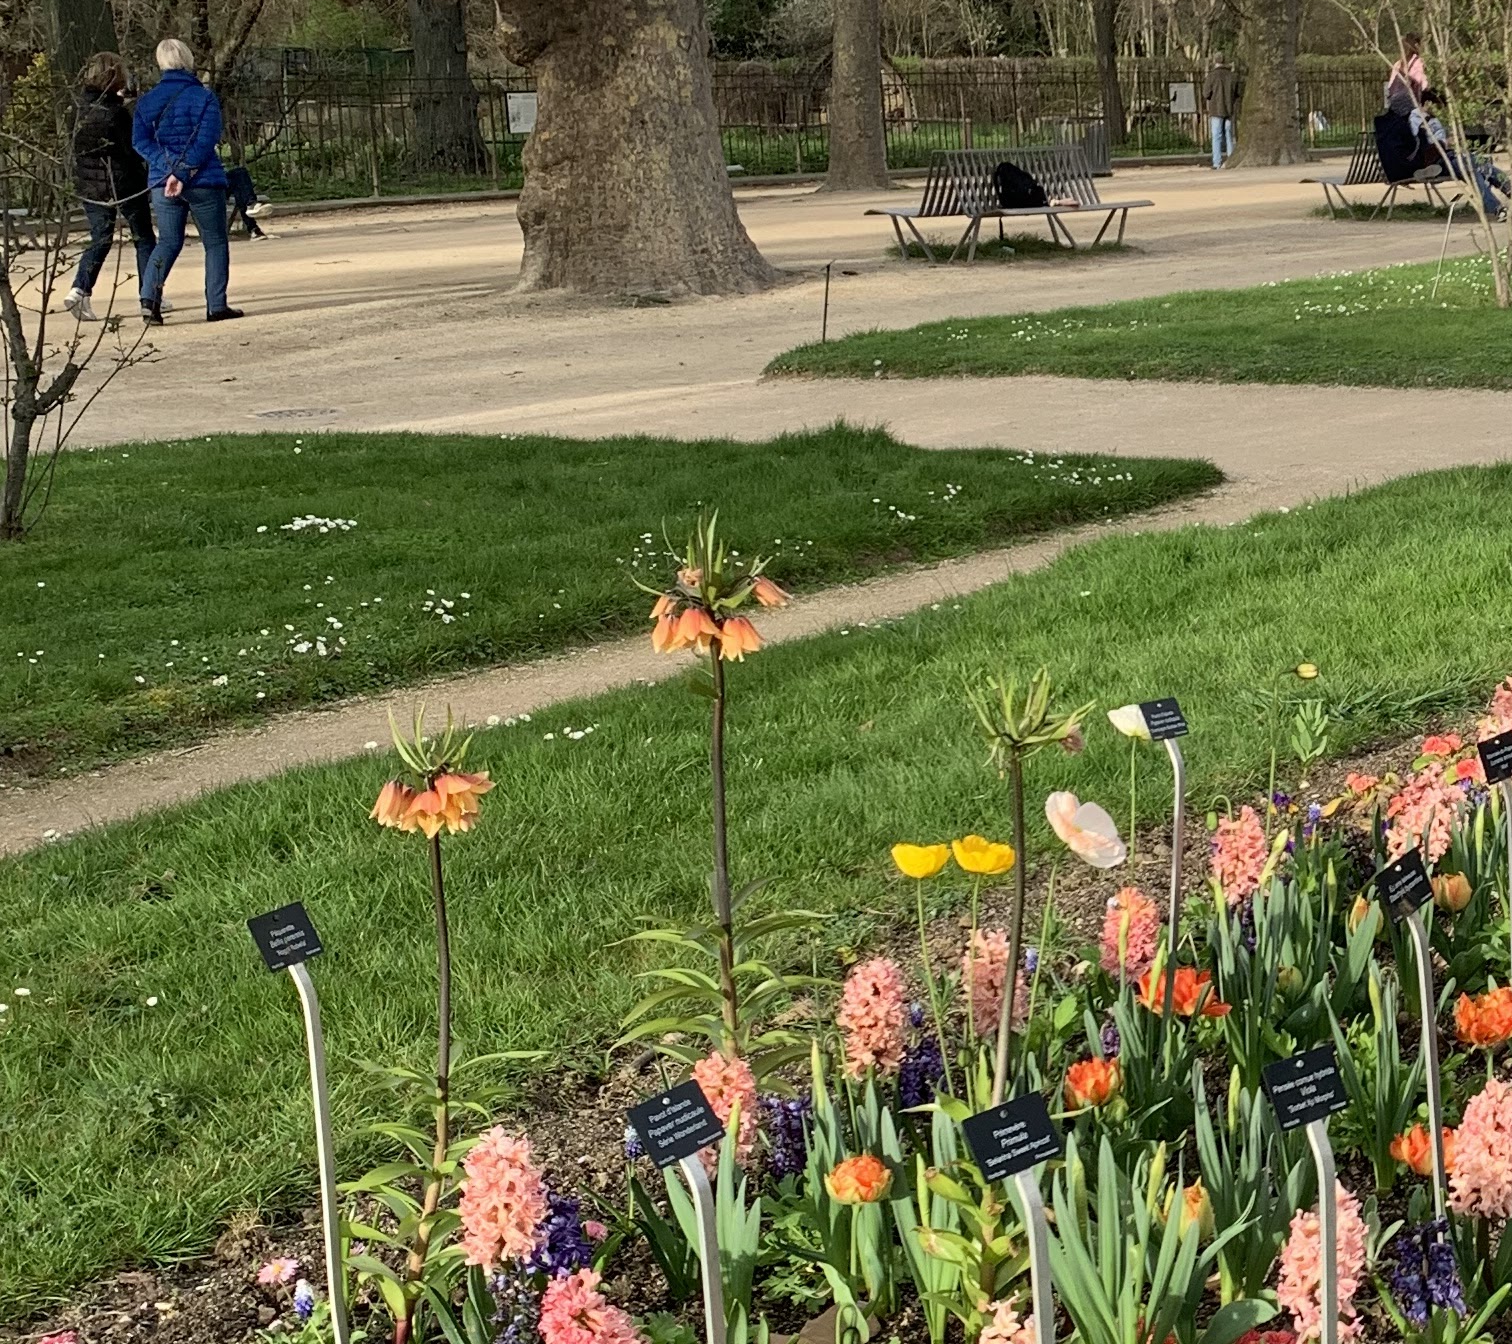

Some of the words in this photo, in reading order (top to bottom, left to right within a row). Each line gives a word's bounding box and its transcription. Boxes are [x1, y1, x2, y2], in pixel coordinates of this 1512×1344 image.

[647, 1121, 675, 1138] Papaver
[675, 1106, 705, 1125] nudicaule
[673, 1119, 708, 1139] Wonderland
